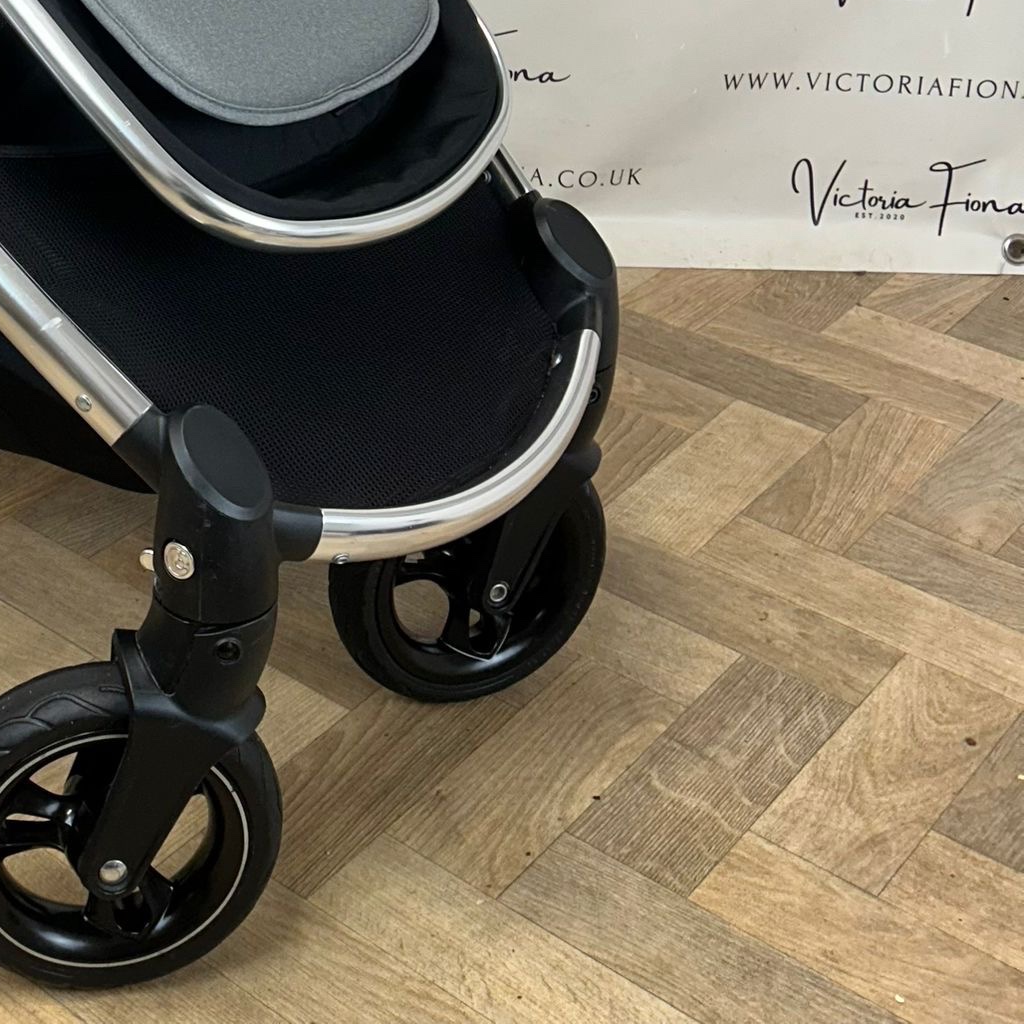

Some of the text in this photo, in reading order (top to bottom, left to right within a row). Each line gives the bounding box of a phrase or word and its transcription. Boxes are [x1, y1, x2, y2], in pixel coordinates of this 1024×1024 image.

[724, 72, 1024, 100] WWW.VICTORIAFION
[791, 158, 927, 227] Victoria
[854, 212, 906, 220] EST.2020
